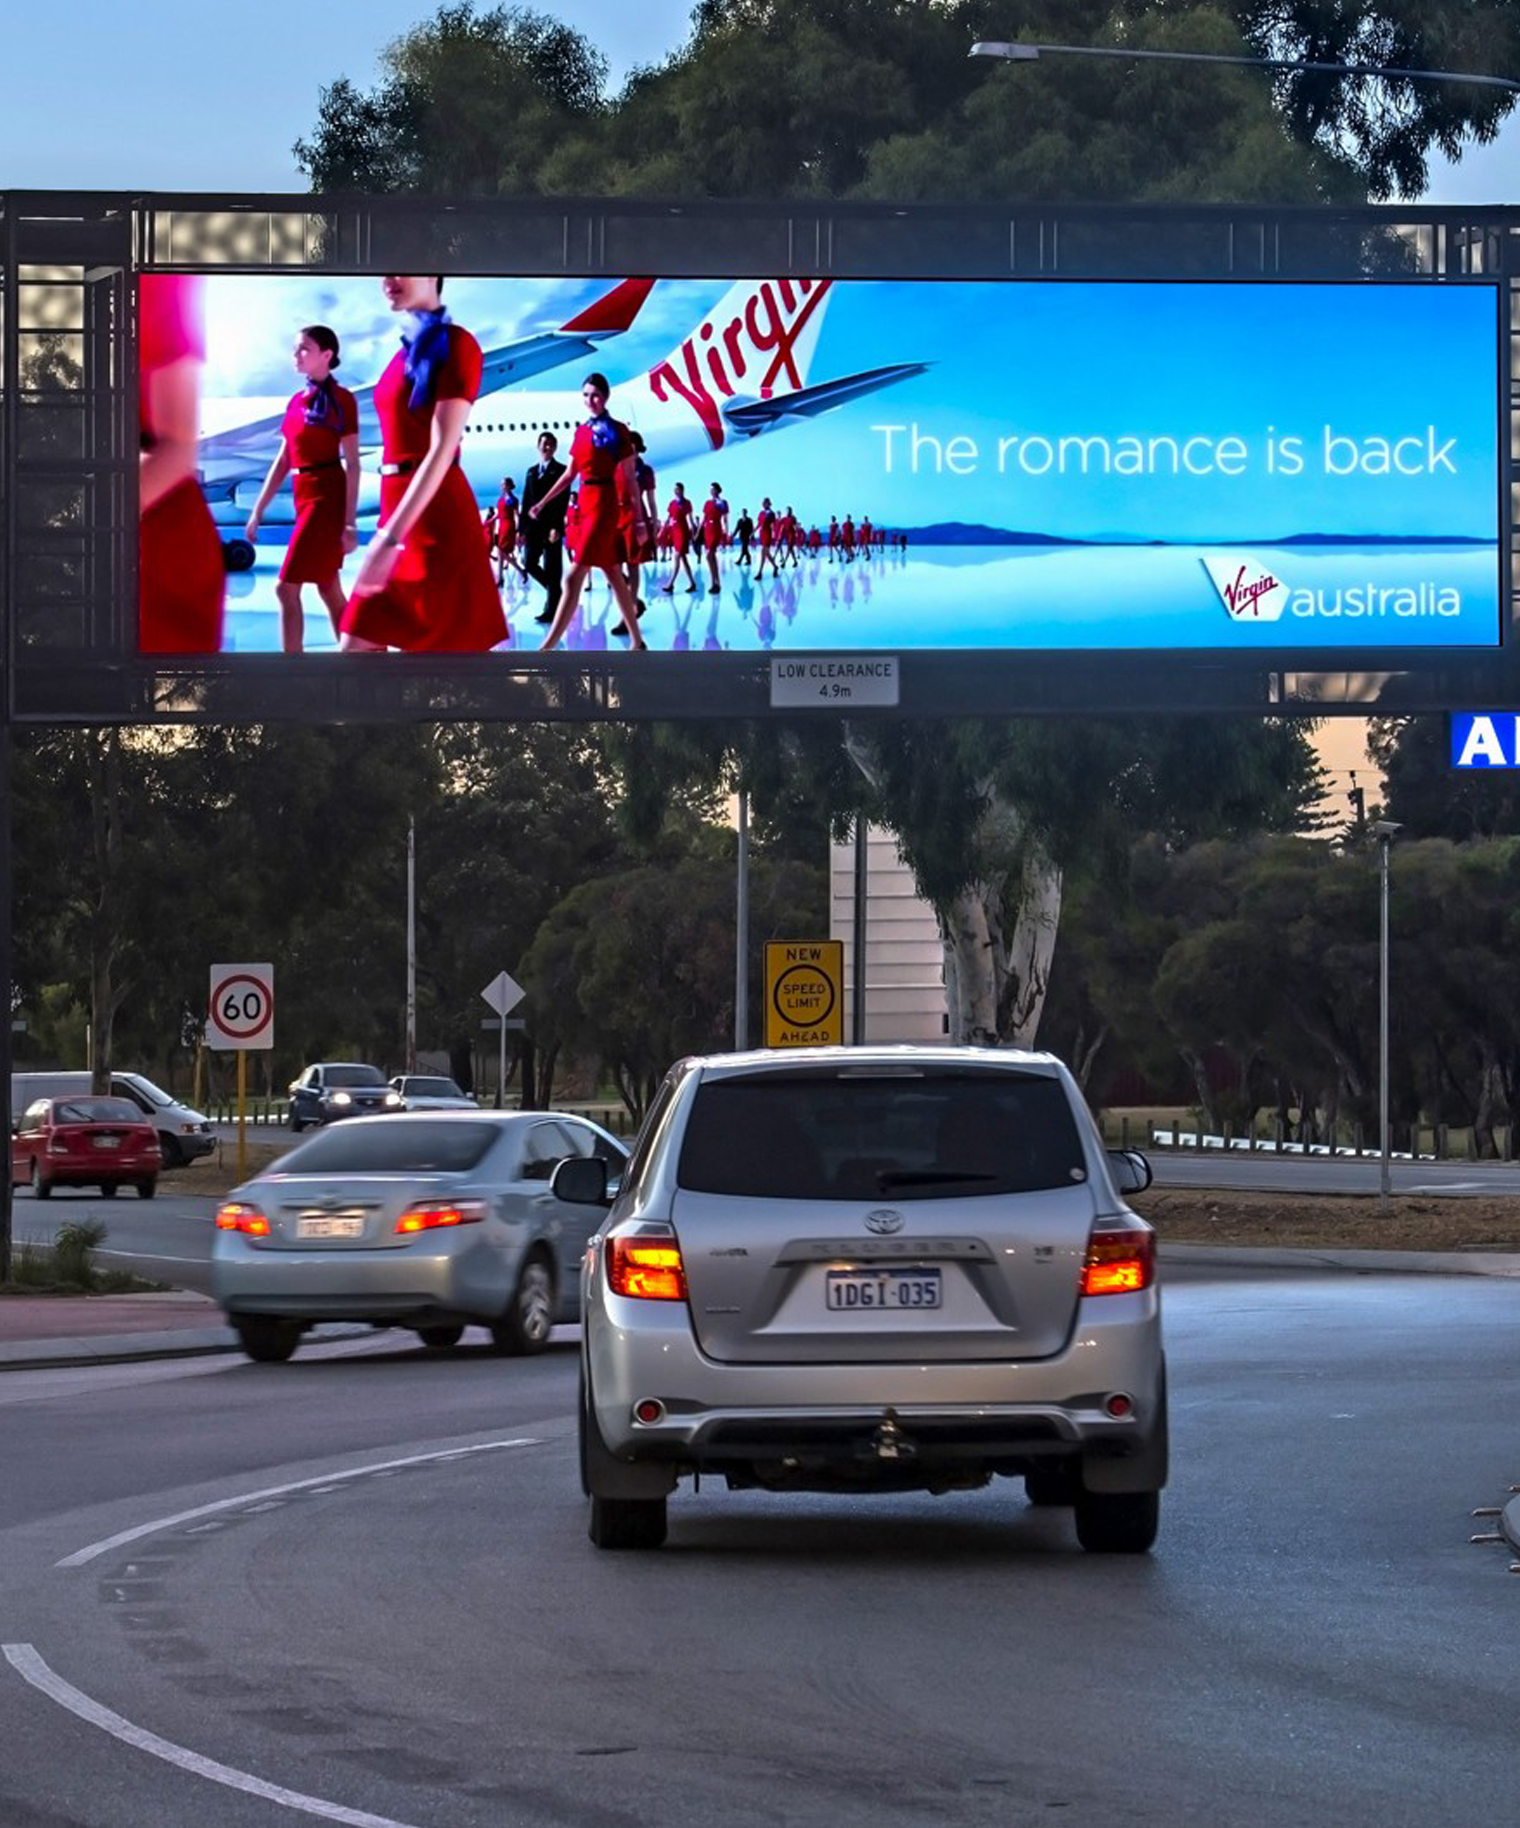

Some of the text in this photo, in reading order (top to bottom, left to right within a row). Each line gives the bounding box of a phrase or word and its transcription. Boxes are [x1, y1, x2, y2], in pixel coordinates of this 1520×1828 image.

[870, 423, 1457, 475] The romance is back
[1224, 565, 1461, 617] Virgin australia
[777, 663, 892, 678] LOW CLEARANCE
[819, 684, 851, 697] 4.9m
[786, 948, 821, 960] NEW
[783, 983, 826, 995] SPEED
[223, 992, 261, 1020] 60
[786, 998, 821, 1008] LIMIT
[780, 1031, 830, 1042] AHEAD
